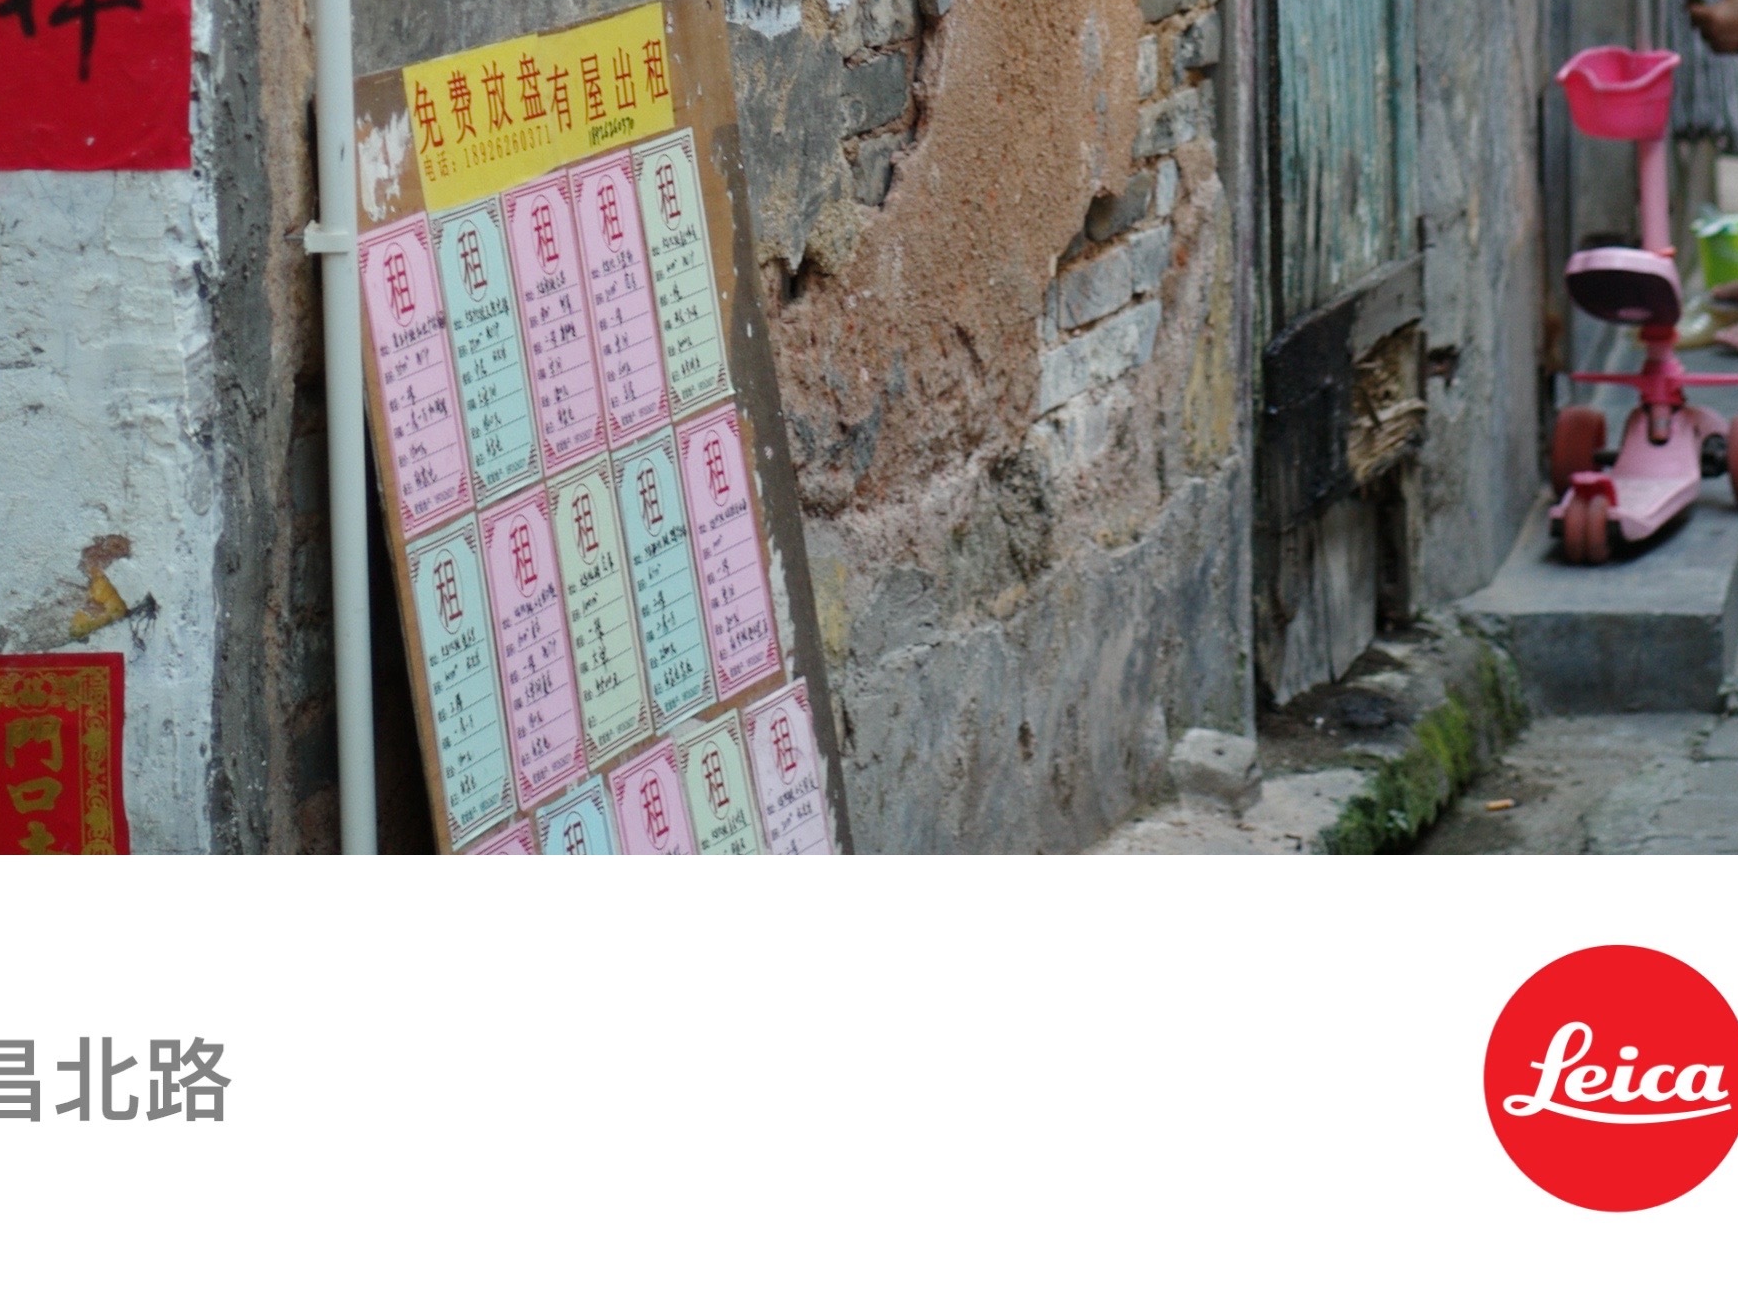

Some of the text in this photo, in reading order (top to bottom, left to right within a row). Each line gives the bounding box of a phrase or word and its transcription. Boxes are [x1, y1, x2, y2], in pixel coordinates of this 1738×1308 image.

[413, 38, 670, 155] 免费放盘有屋出租
[597, 184, 624, 246] 租
[656, 164, 682, 224] 租
[458, 230, 488, 295] 租
[531, 205, 560, 268] 租
[384, 252, 416, 320] 租
[636, 466, 663, 533] 租
[703, 438, 731, 499] 租
[510, 524, 539, 591] 租
[572, 492, 600, 558] 租
[434, 557, 463, 629] 租
[770, 715, 797, 781] 租
[640, 777, 670, 847] 租
[701, 750, 730, 816] 租
